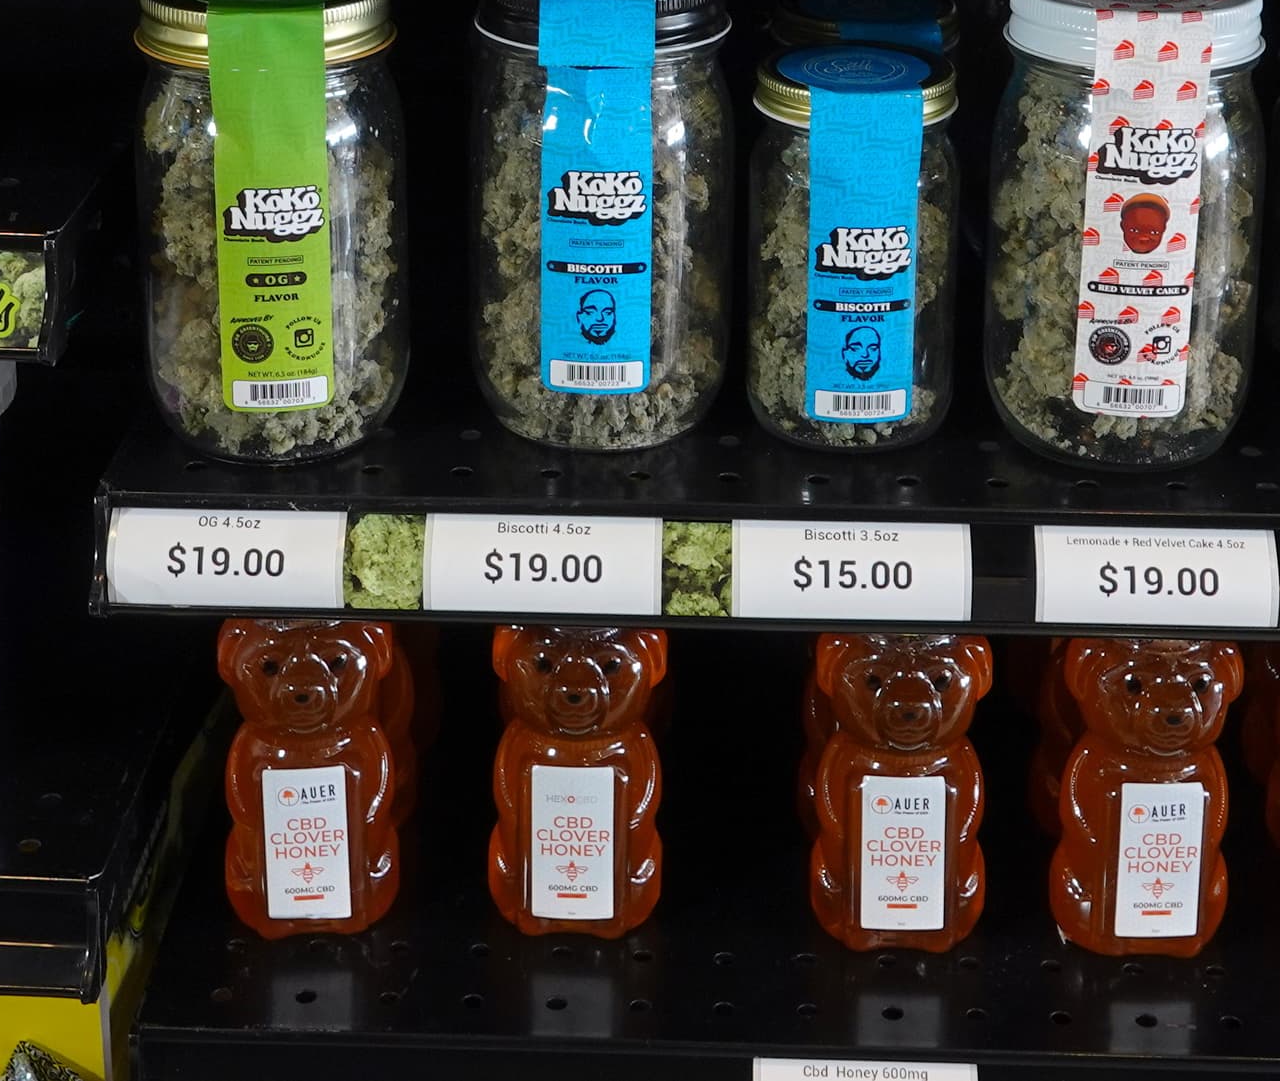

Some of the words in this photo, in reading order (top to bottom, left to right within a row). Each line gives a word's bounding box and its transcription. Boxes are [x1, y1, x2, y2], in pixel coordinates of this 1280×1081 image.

[230, 206, 324, 236] Nuggz
[567, 264, 623, 274] BISCOTTI
[265, 272, 289, 286] OG
[574, 275, 619, 285] FLAVOR
[1097, 284, 1118, 293] RED
[1120, 286, 1154, 295] VELVET
[1156, 286, 1181, 295] CAKE
[254, 293, 300, 303] FLAVOR
[198, 515, 218, 527] OG
[222, 516, 261, 530] 4.5oz
[497, 521, 550, 535] Biscotti
[552, 523, 591, 536] 4.5oz
[804, 528, 857, 542] Biscotti
[860, 530, 899, 543] 3.5oz
[1066, 535, 1121, 547] Lemonade
[1132, 537, 1152, 548] Red
[1155, 538, 1187, 548] Velvet
[1189, 538, 1215, 549] Cake
[1216, 540, 1245, 550] 4.5oz
[166, 541, 285, 578] $19.00
[484, 548, 603, 585] $19.00
[793, 555, 913, 592] $15.00
[1098, 561, 1220, 597] $19.00
[300, 784, 336, 800] AUER
[287, 817, 327, 831] CBD
[270, 829, 344, 845] CLOVER
[275, 843, 341, 860] HONEY
[803, 1064, 828, 1078] Cbd
[836, 1065, 879, 1081] Honey
[882, 1067, 928, 1081] 600mg
